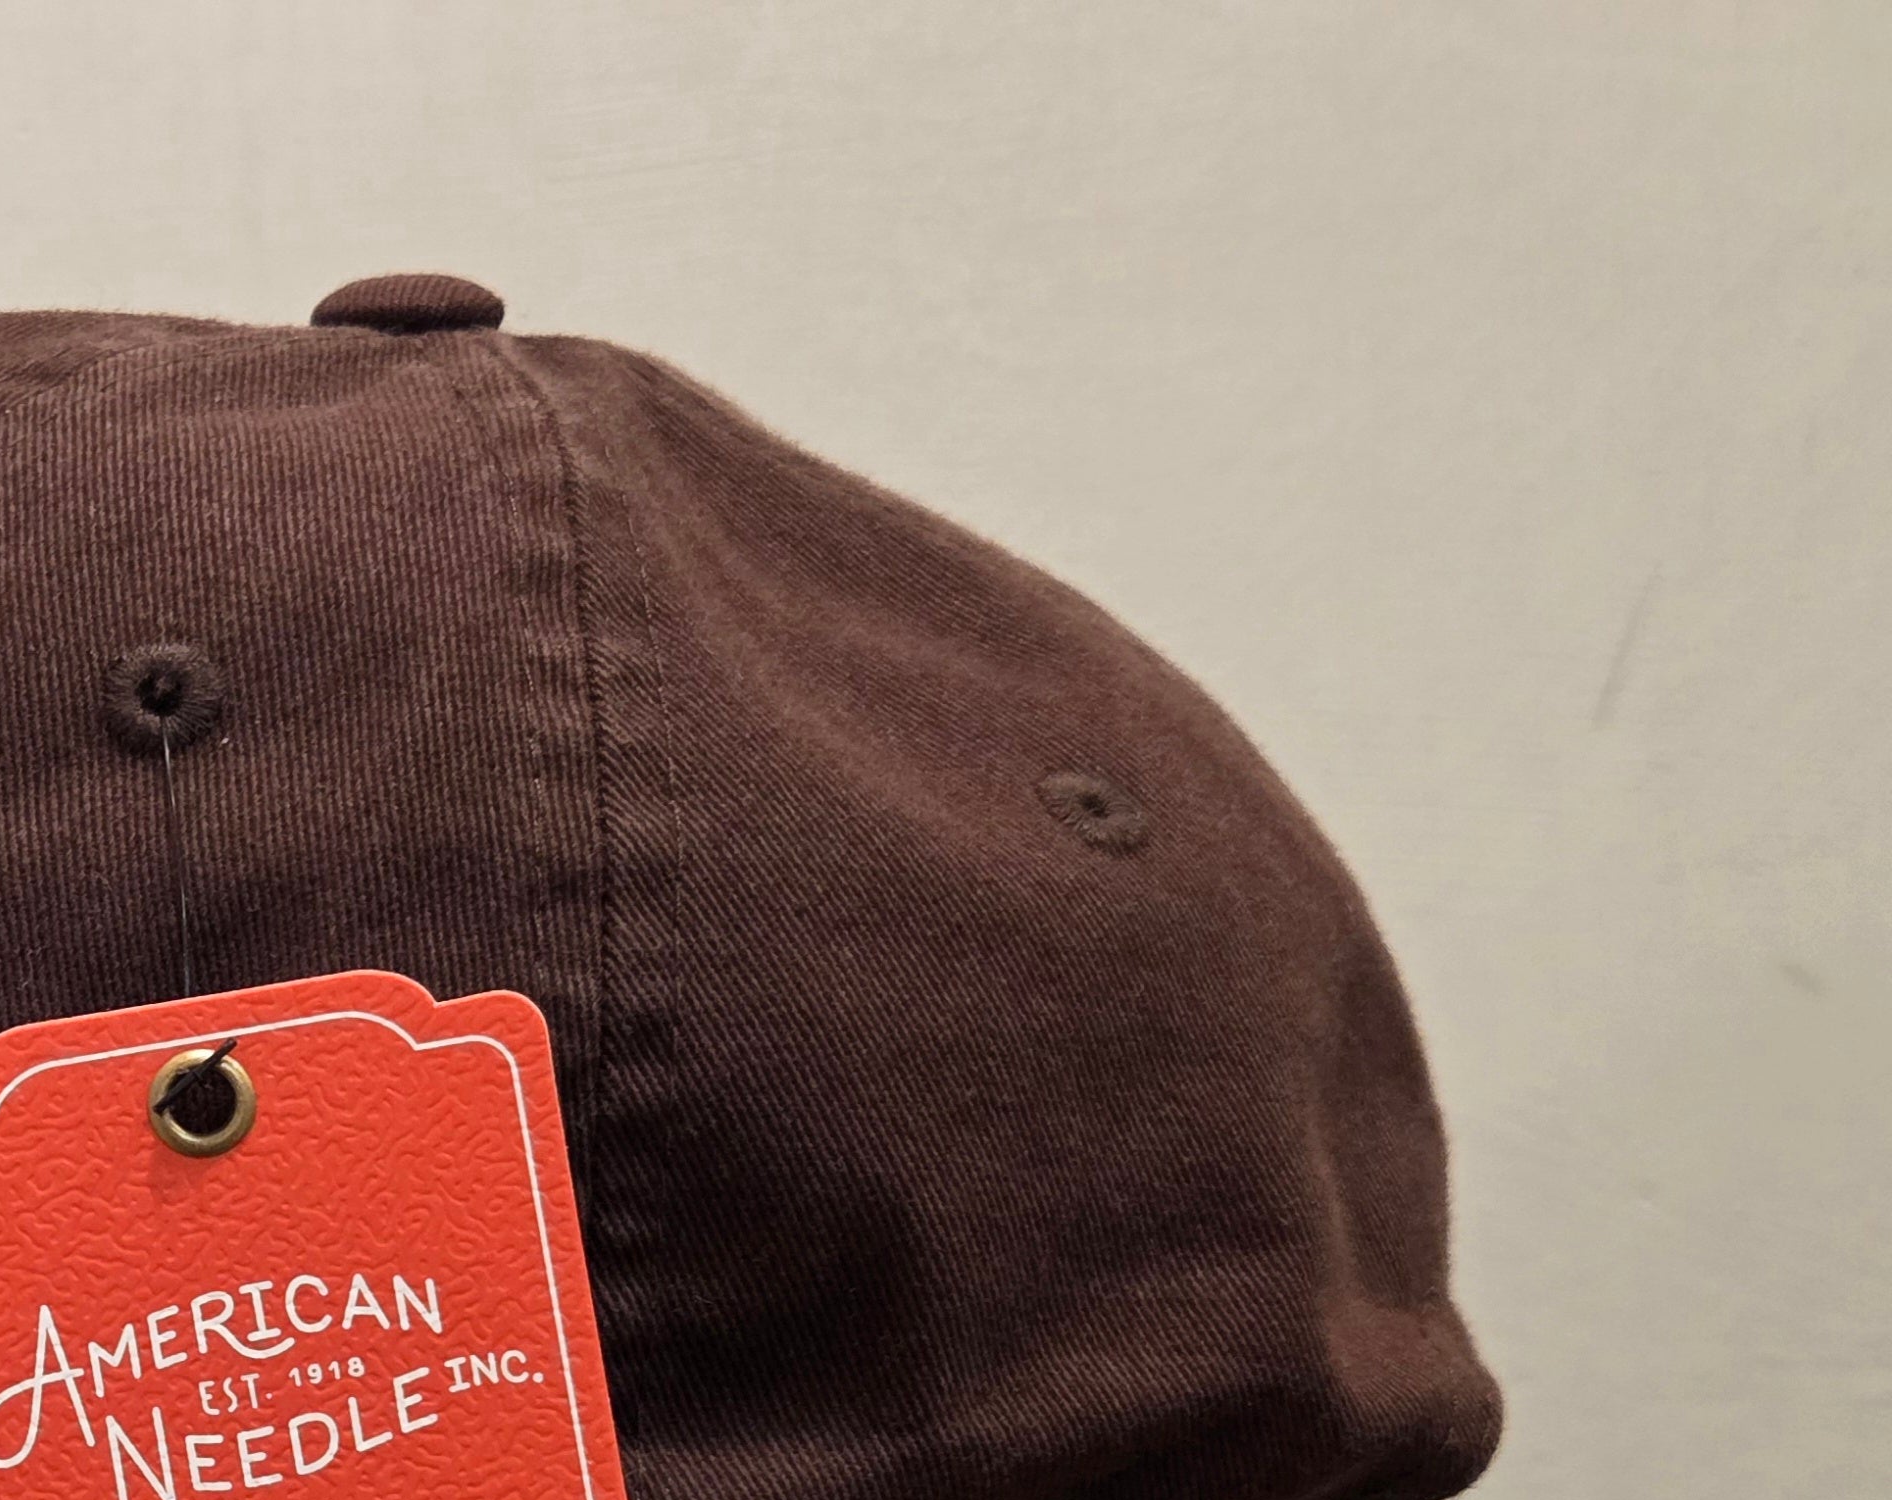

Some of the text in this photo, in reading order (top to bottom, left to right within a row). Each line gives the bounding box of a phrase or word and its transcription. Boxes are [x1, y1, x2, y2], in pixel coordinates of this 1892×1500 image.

[198, 1355, 367, 1416] EST. 1918
[444, 1349, 545, 1394] INC.
